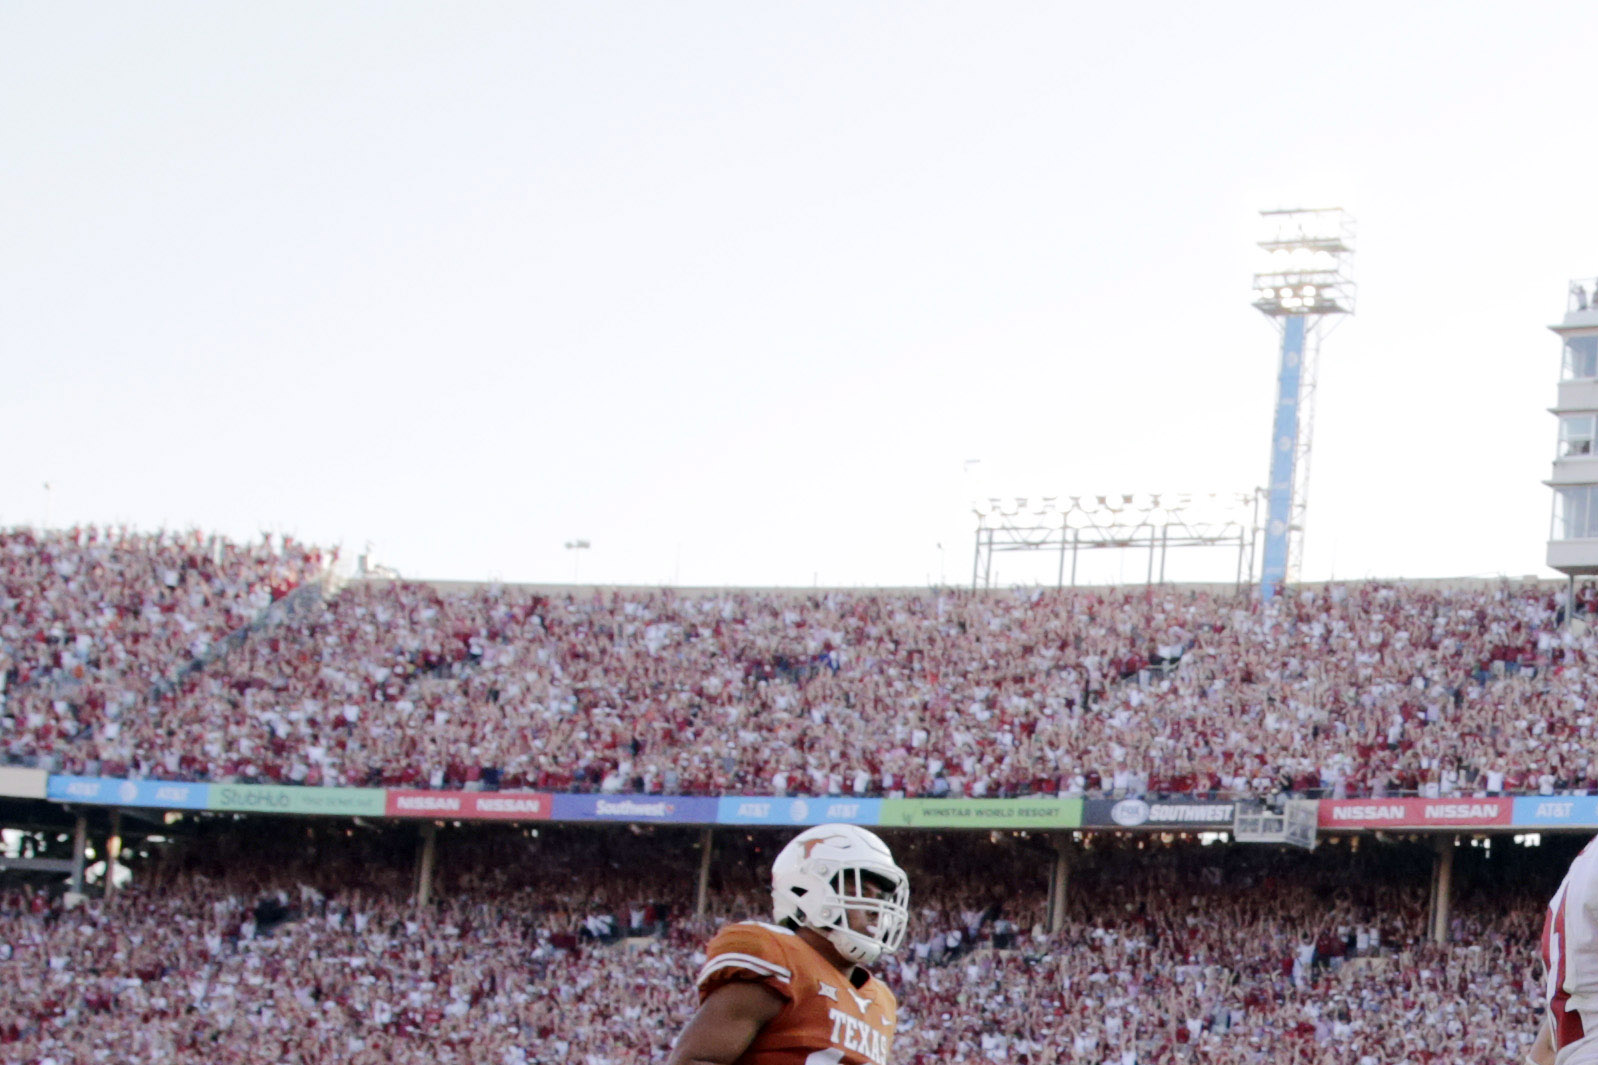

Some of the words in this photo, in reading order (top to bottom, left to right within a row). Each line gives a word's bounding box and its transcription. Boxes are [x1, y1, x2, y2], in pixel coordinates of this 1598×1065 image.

[220, 788, 291, 808] StubHub
[397, 796, 461, 811] NISSAN
[476, 798, 540, 813] NISSAN
[595, 799, 666, 817] Southwest
[737, 802, 771, 818] AT&T
[826, 803, 860, 819] AT&T
[923, 807, 971, 818] WINSTAR
[975, 807, 1015, 818] WORLD
[1018, 807, 1060, 818] RESORT
[1149, 804, 1234, 821] SOUTHWEST
[1333, 805, 1406, 820] NISSAN
[1425, 804, 1499, 819] NISSAN
[1535, 801, 1574, 818] AT&T
